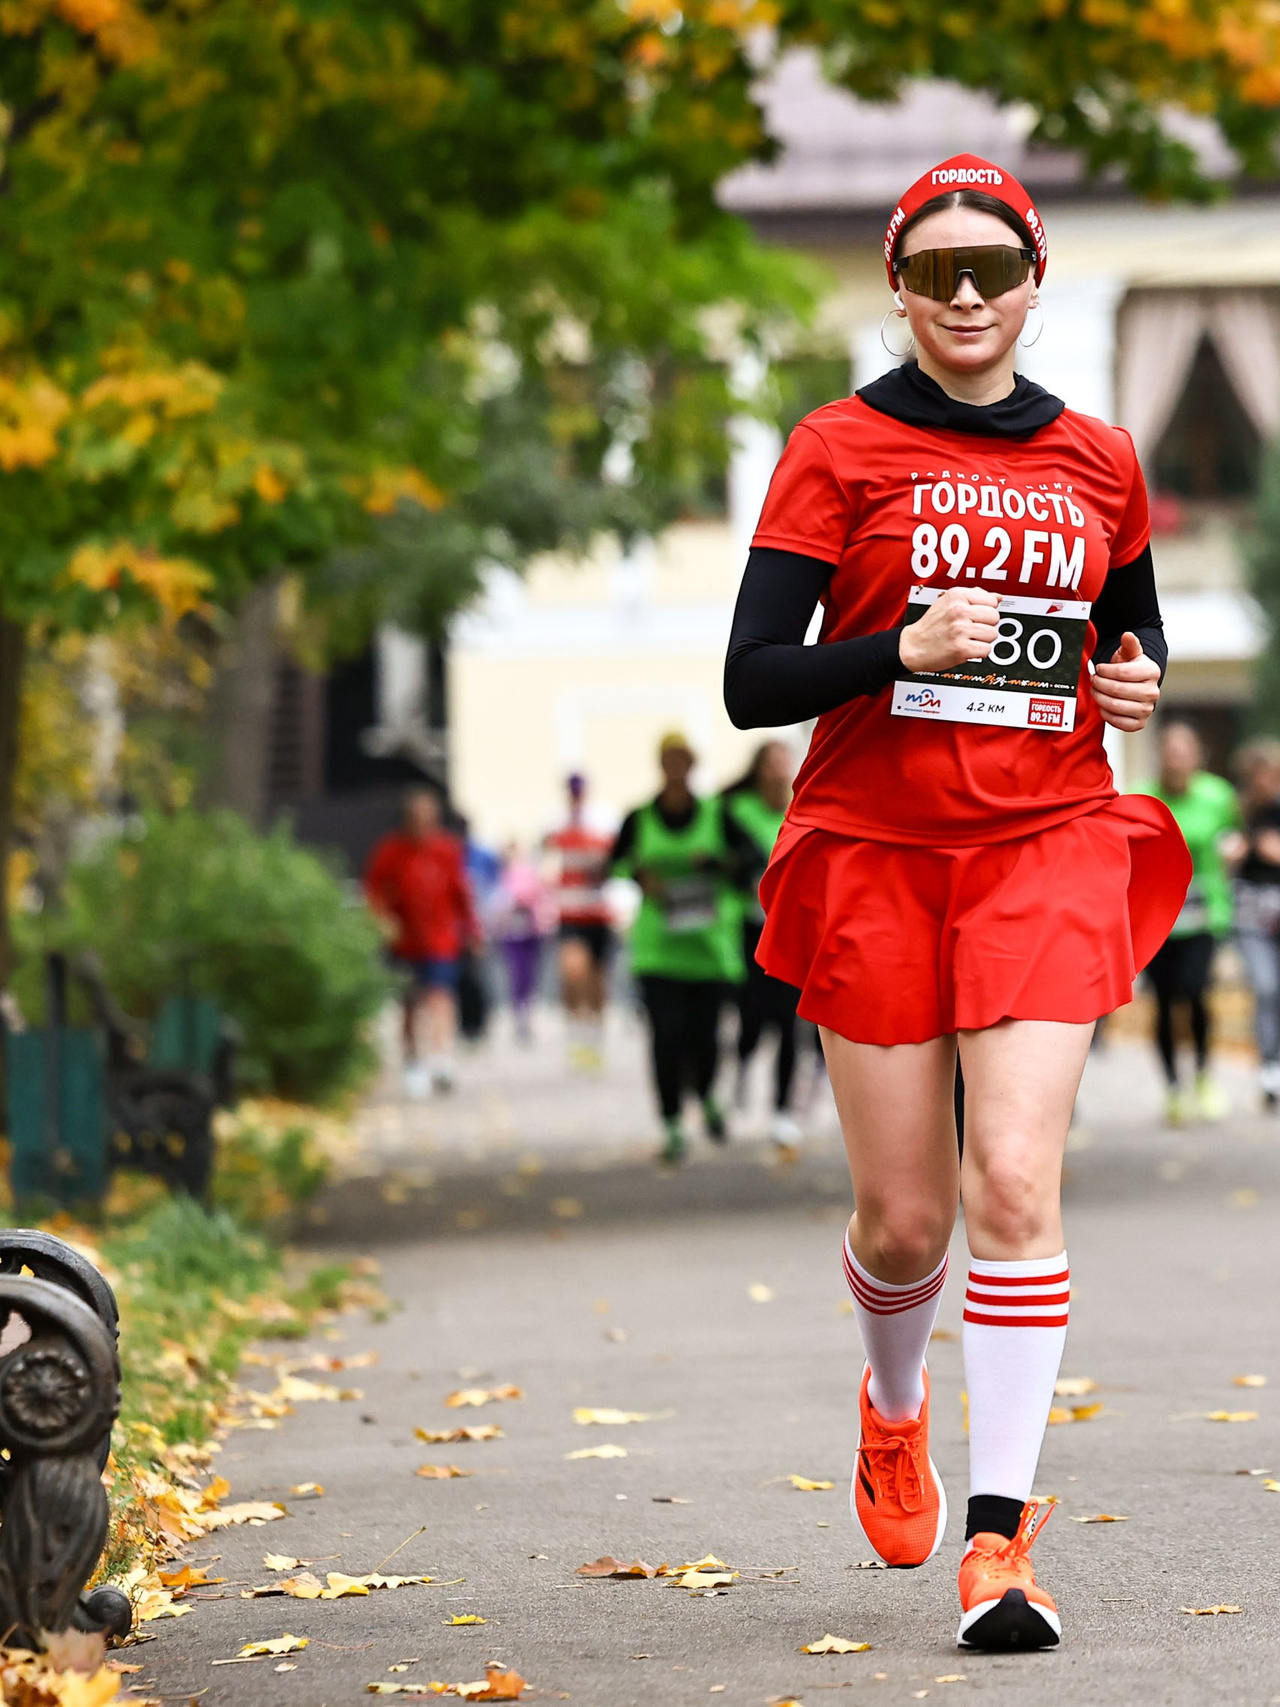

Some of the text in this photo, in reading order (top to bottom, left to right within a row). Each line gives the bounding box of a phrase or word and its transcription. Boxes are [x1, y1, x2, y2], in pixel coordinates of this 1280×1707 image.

[931, 168, 1003, 185] ГОРДОСТЬ
[889, 206, 906, 234] FM
[1026, 208, 1043, 242] 89.2
[912, 480, 1085, 528] ГОРДОСТЬ
[910, 522, 1086, 590] 89.2 FM
[967, 617, 1062, 670] 80
[966, 701, 986, 713] 4.2
[1030, 711, 1061, 724] 89.2 FM
[1031, 703, 1062, 713] ГОРДОСТЬ
